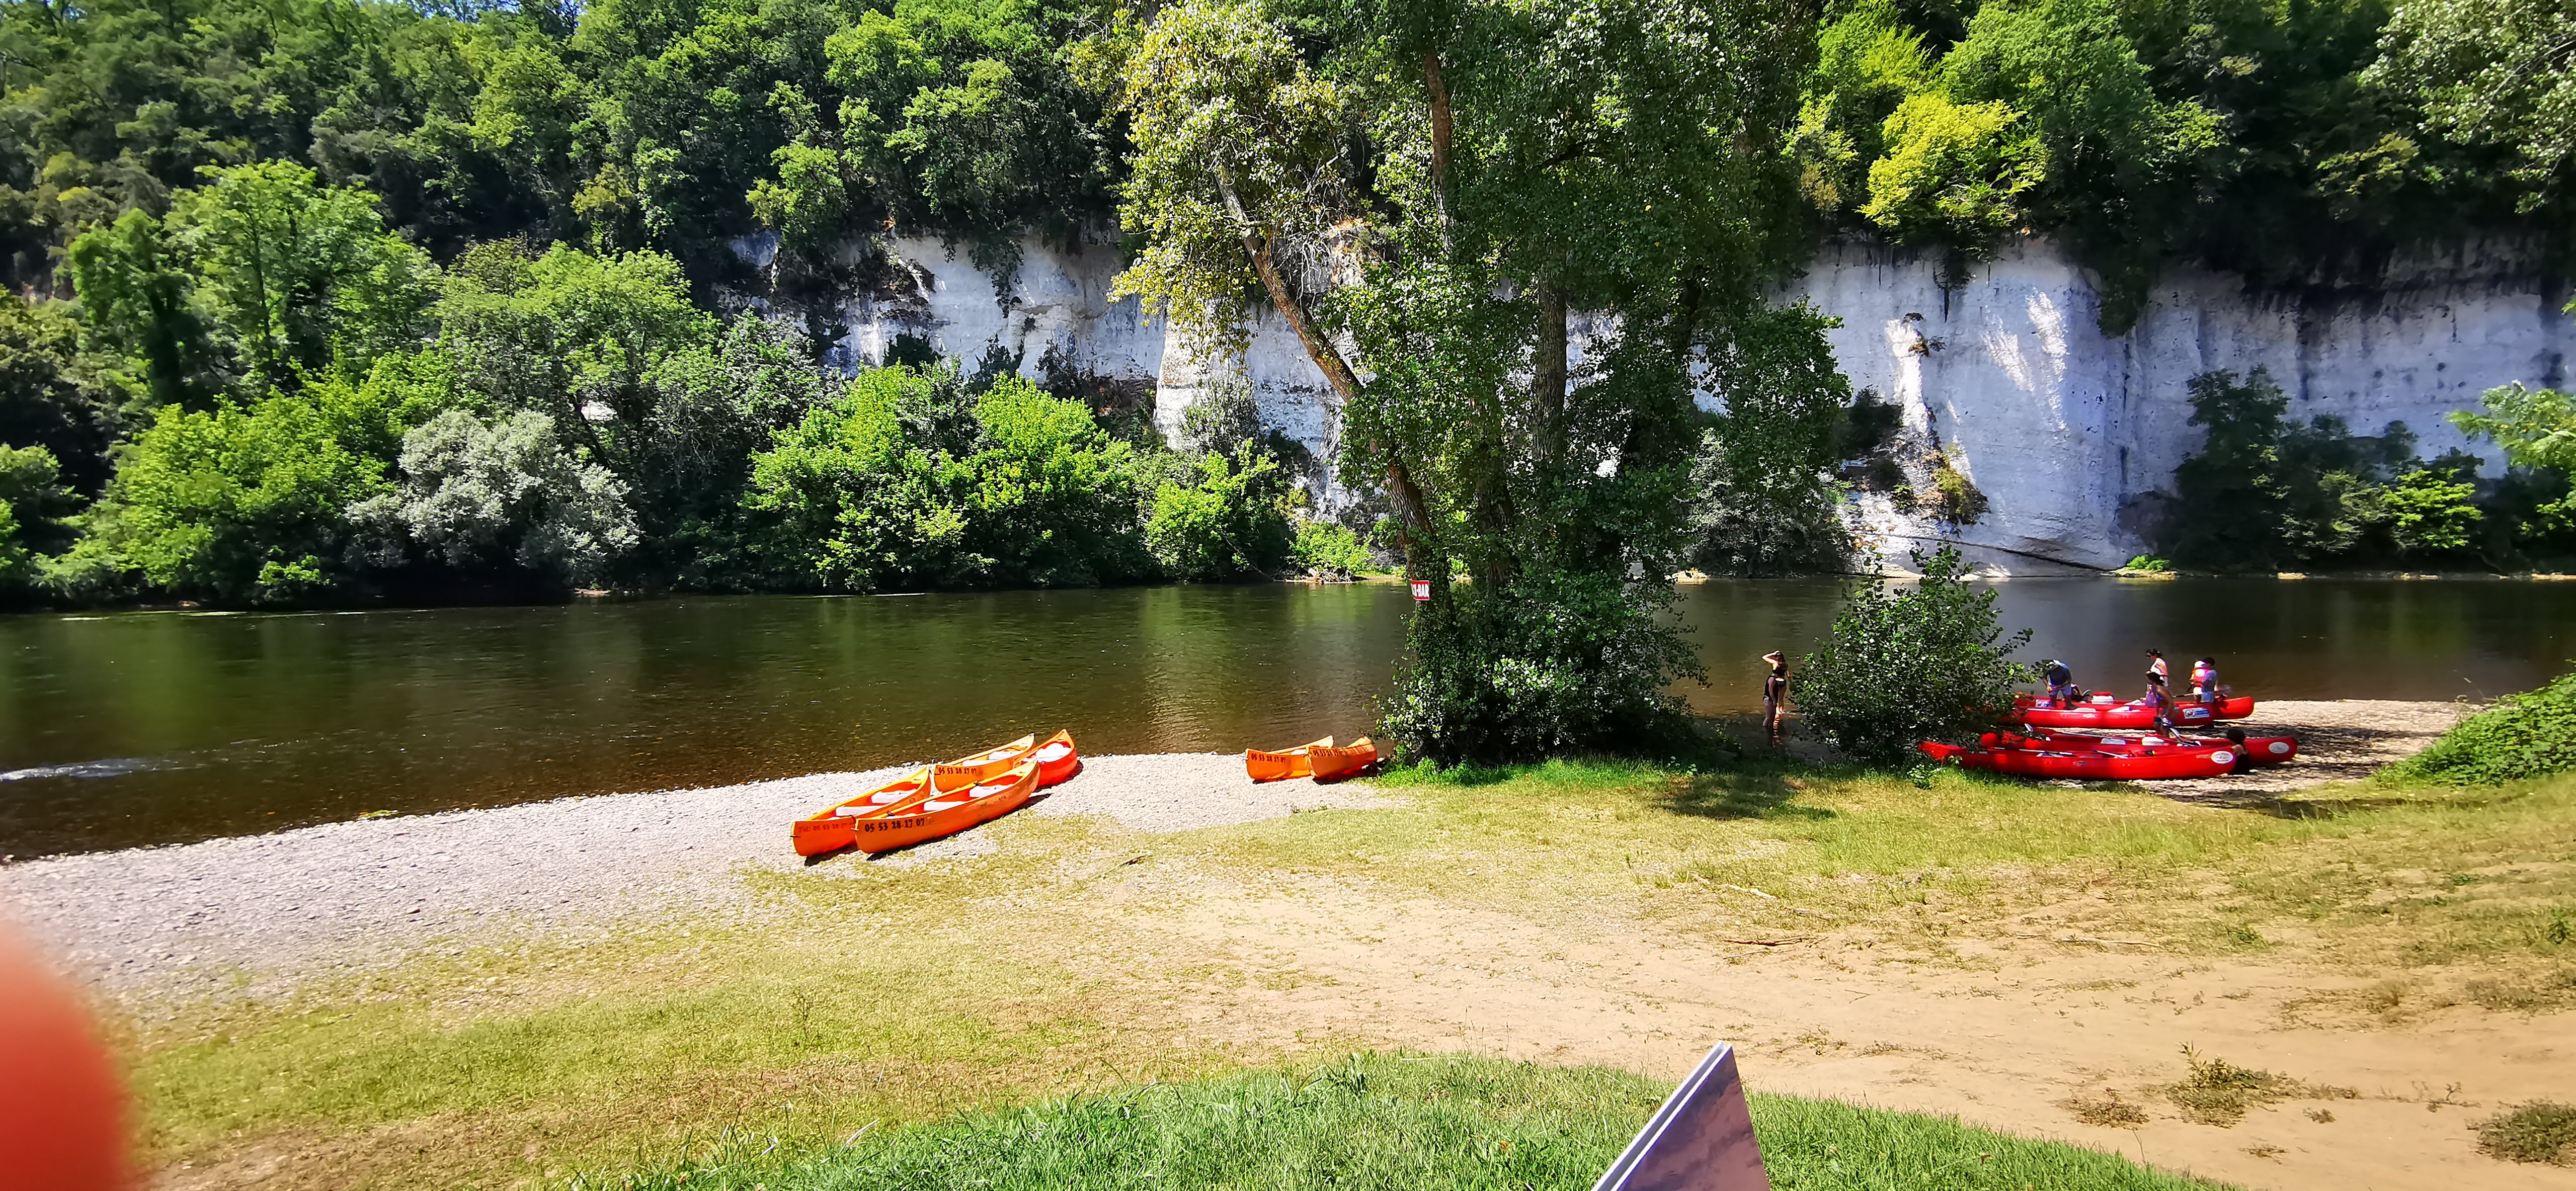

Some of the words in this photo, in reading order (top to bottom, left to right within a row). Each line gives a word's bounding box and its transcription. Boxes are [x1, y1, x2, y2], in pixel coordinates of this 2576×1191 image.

[864, 823, 874, 832] 05
[878, 822, 888, 831] 53
[892, 820, 901, 829] 28
[905, 819, 912, 828] 17
[916, 818, 924, 826] 07
